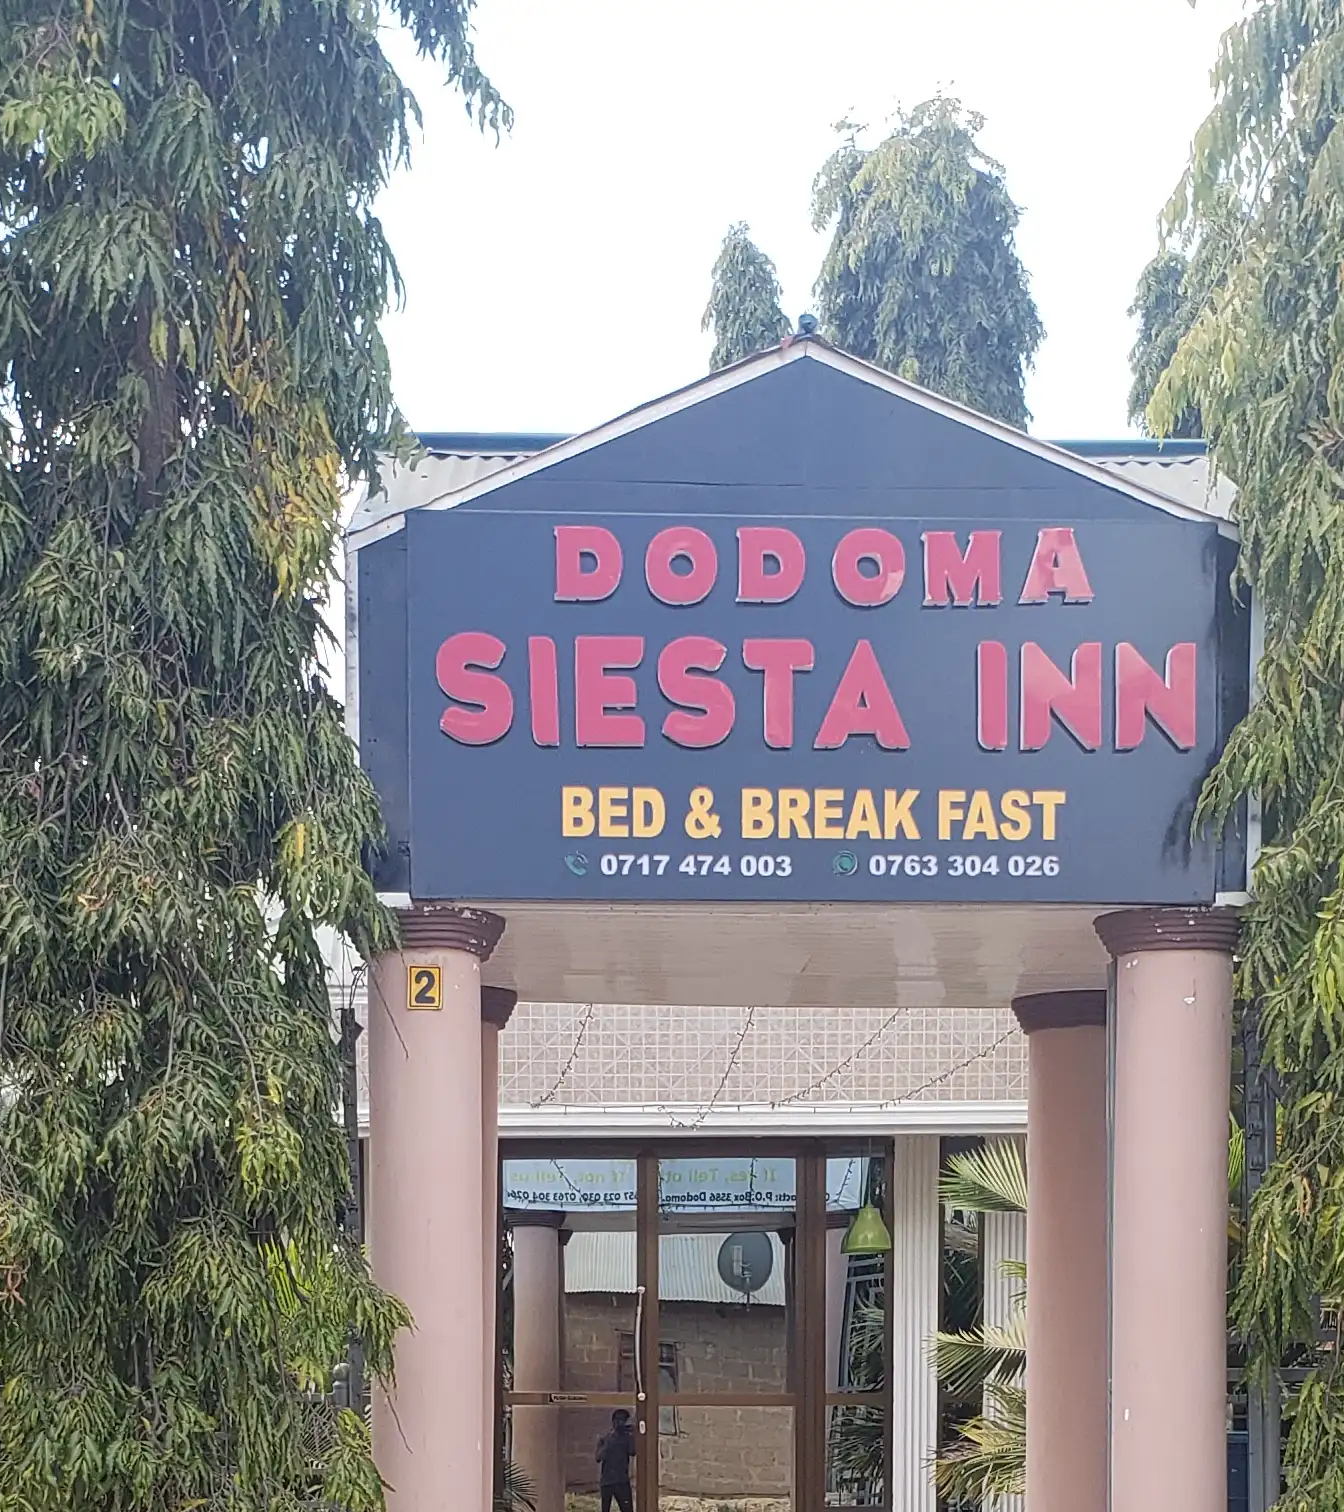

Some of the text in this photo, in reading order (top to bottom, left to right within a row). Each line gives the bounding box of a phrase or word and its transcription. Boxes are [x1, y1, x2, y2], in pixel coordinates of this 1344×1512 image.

[553, 525, 1096, 606] DODOMA
[435, 632, 1198, 752] SIESTA INN
[561, 785, 1067, 842] BED & BREAK FAST
[600, 854, 1061, 876] 0717 474 003 0763 304 026
[414, 970, 436, 1004] 2
